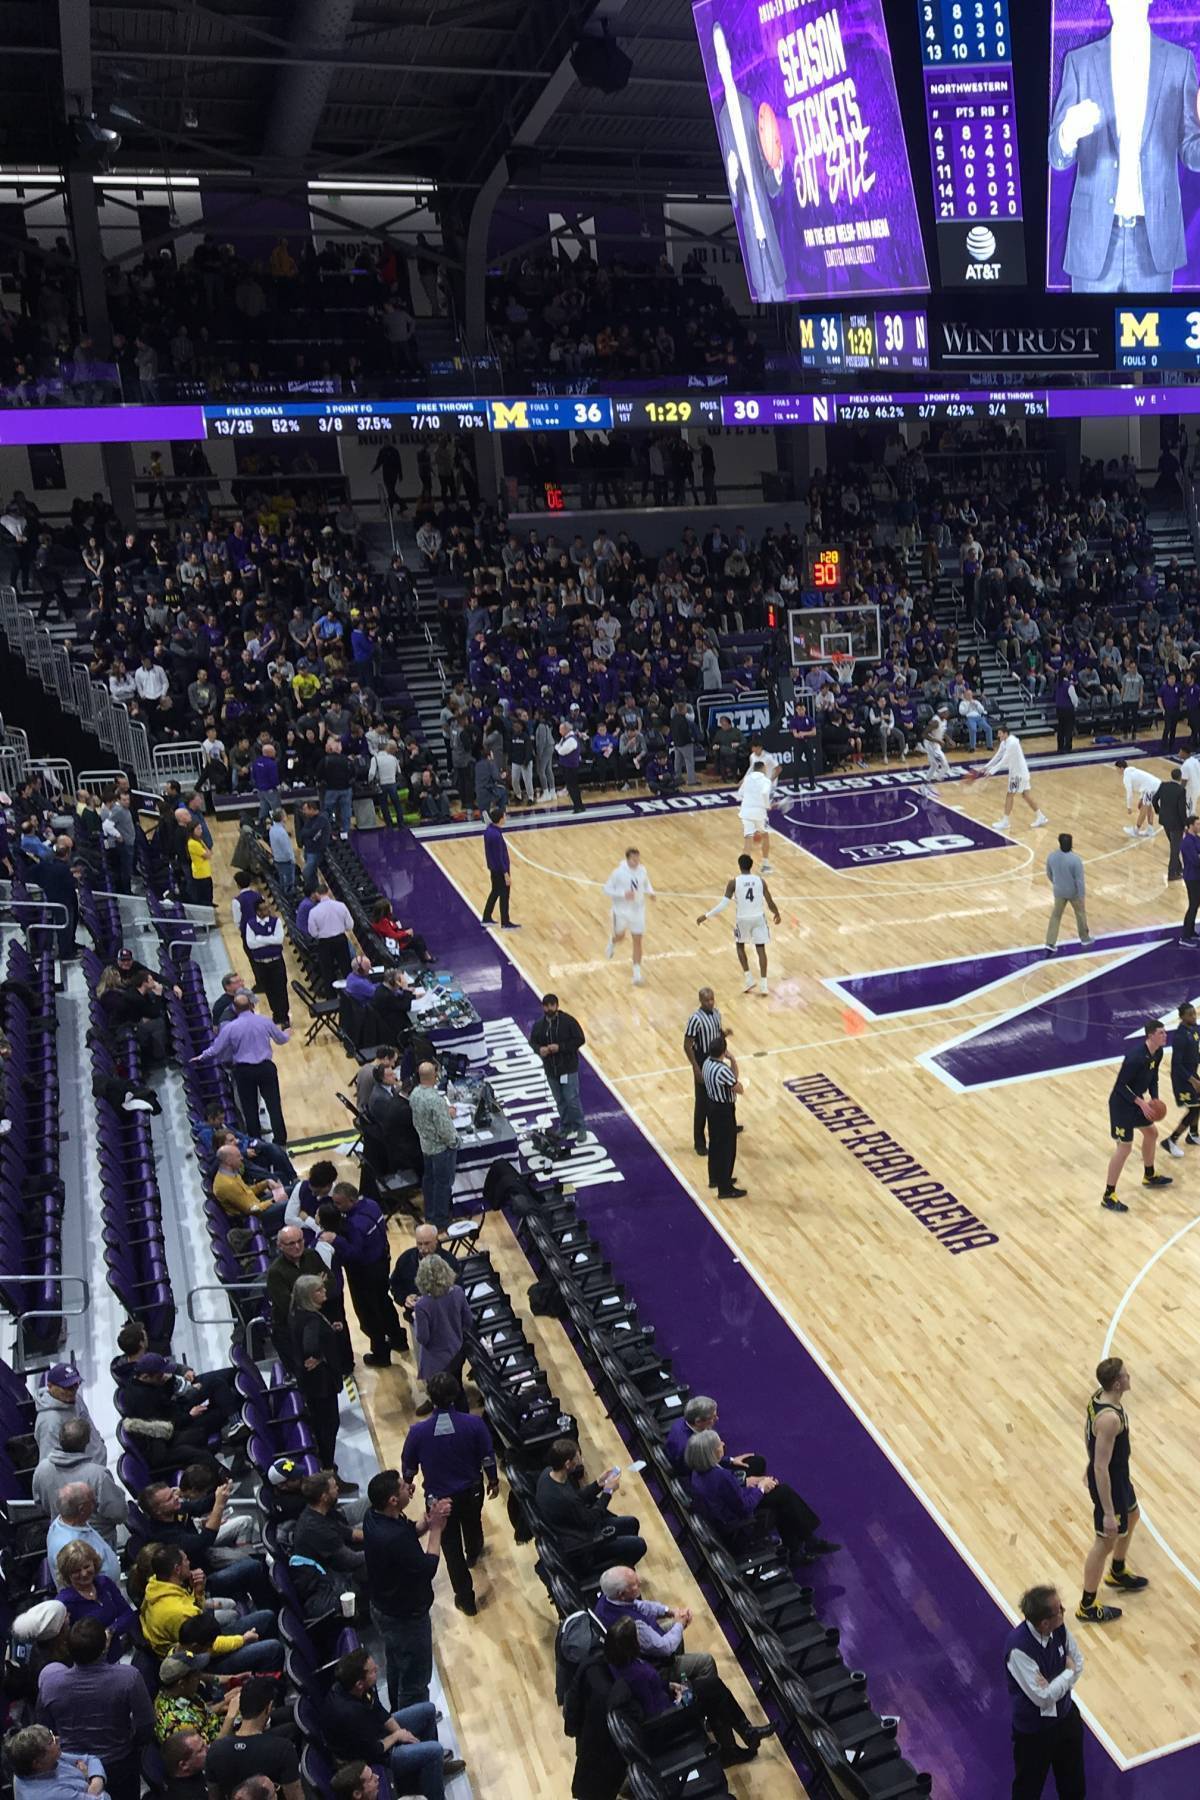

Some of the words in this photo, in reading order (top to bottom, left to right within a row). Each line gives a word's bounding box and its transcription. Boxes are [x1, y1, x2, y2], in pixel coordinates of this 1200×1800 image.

[924, 6, 932, 21] 3
[952, 4, 962, 19] 8
[975, 3, 983, 18] 3
[994, 2, 1001, 16] 1
[926, 25, 935, 40] 4
[954, 24, 963, 39] 0
[976, 23, 984, 38] 3
[996, 22, 1004, 36] 0
[778, 8, 846, 98] SEASON
[927, 45, 942, 60] 13
[952, 44, 967, 59] 10
[978, 42, 986, 57] 1
[997, 41, 1005, 56] 0
[930, 81, 1008, 94] NORTHWESTERN
[956, 107, 974, 118] PTS
[981, 106, 995, 117] RB
[1002, 105, 1008, 116] F
[934, 127, 943, 141] 4
[962, 126, 971, 140] 8
[984, 125, 992, 139] 2
[1003, 124, 1010, 138] 3
[936, 146, 944, 160] 5
[960, 146, 975, 159] 16
[985, 145, 994, 158] 4
[1005, 144, 1012, 157] 0
[937, 165, 951, 179] 11
[965, 164, 974, 178] 0
[987, 163, 995, 177] 3
[1006, 163, 1012, 176] 1
[939, 184, 953, 198] 14
[966, 183, 975, 196] 4
[988, 182, 997, 196] 0
[1007, 182, 1014, 195] 2
[941, 202, 954, 216] 21
[968, 202, 977, 216] 0
[990, 201, 998, 214] 2
[1009, 200, 1016, 214] 0
[966, 264, 1001, 280] AT&T
[820, 318, 837, 350] 36
[884, 315, 903, 350] 30
[916, 316, 925, 349] N
[1120, 312, 1159, 347] M
[848, 328, 872, 354] 1:29
[942, 323, 1099, 353] WINTRUST
[1123, 355, 1146, 366] FOULS
[1152, 355, 1157, 366] 0
[1008, 392, 1034, 400] THROWS
[227, 407, 252, 416] FIELD
[254, 406, 283, 415] GOALS
[332, 405, 359, 413] POINT
[362, 405, 372, 413] FG
[439, 403, 474, 411] THROWS
[616, 403, 633, 412] HALF
[645, 403, 692, 422] 1:29
[734, 401, 758, 419] 30
[812, 397, 828, 421] N
[840, 406, 870, 419] 12/26
[875, 406, 904, 418] 46.2%
[919, 404, 935, 417] 3/7
[946, 404, 974, 416] 42.9%
[989, 404, 1006, 416] 3/4
[1025, 403, 1044, 414] 75%
[319, 417, 342, 431] 3/8
[357, 416, 391, 430] 37.5%
[411, 415, 440, 429] 7/10
[458, 415, 484, 428] 70%
[492, 402, 529, 429] M
[574, 403, 601, 423] 36
[619, 414, 630, 422] 1ST
[215, 419, 253, 435] 13/25
[272, 419, 299, 433] 52%
[820, 551, 839, 563] 1:28
[814, 564, 836, 585] 30
[745, 888, 754, 902] 4
[783, 1072, 930, 1184] WELSH-RYAN
[890, 1182, 999, 1255] ARENA
